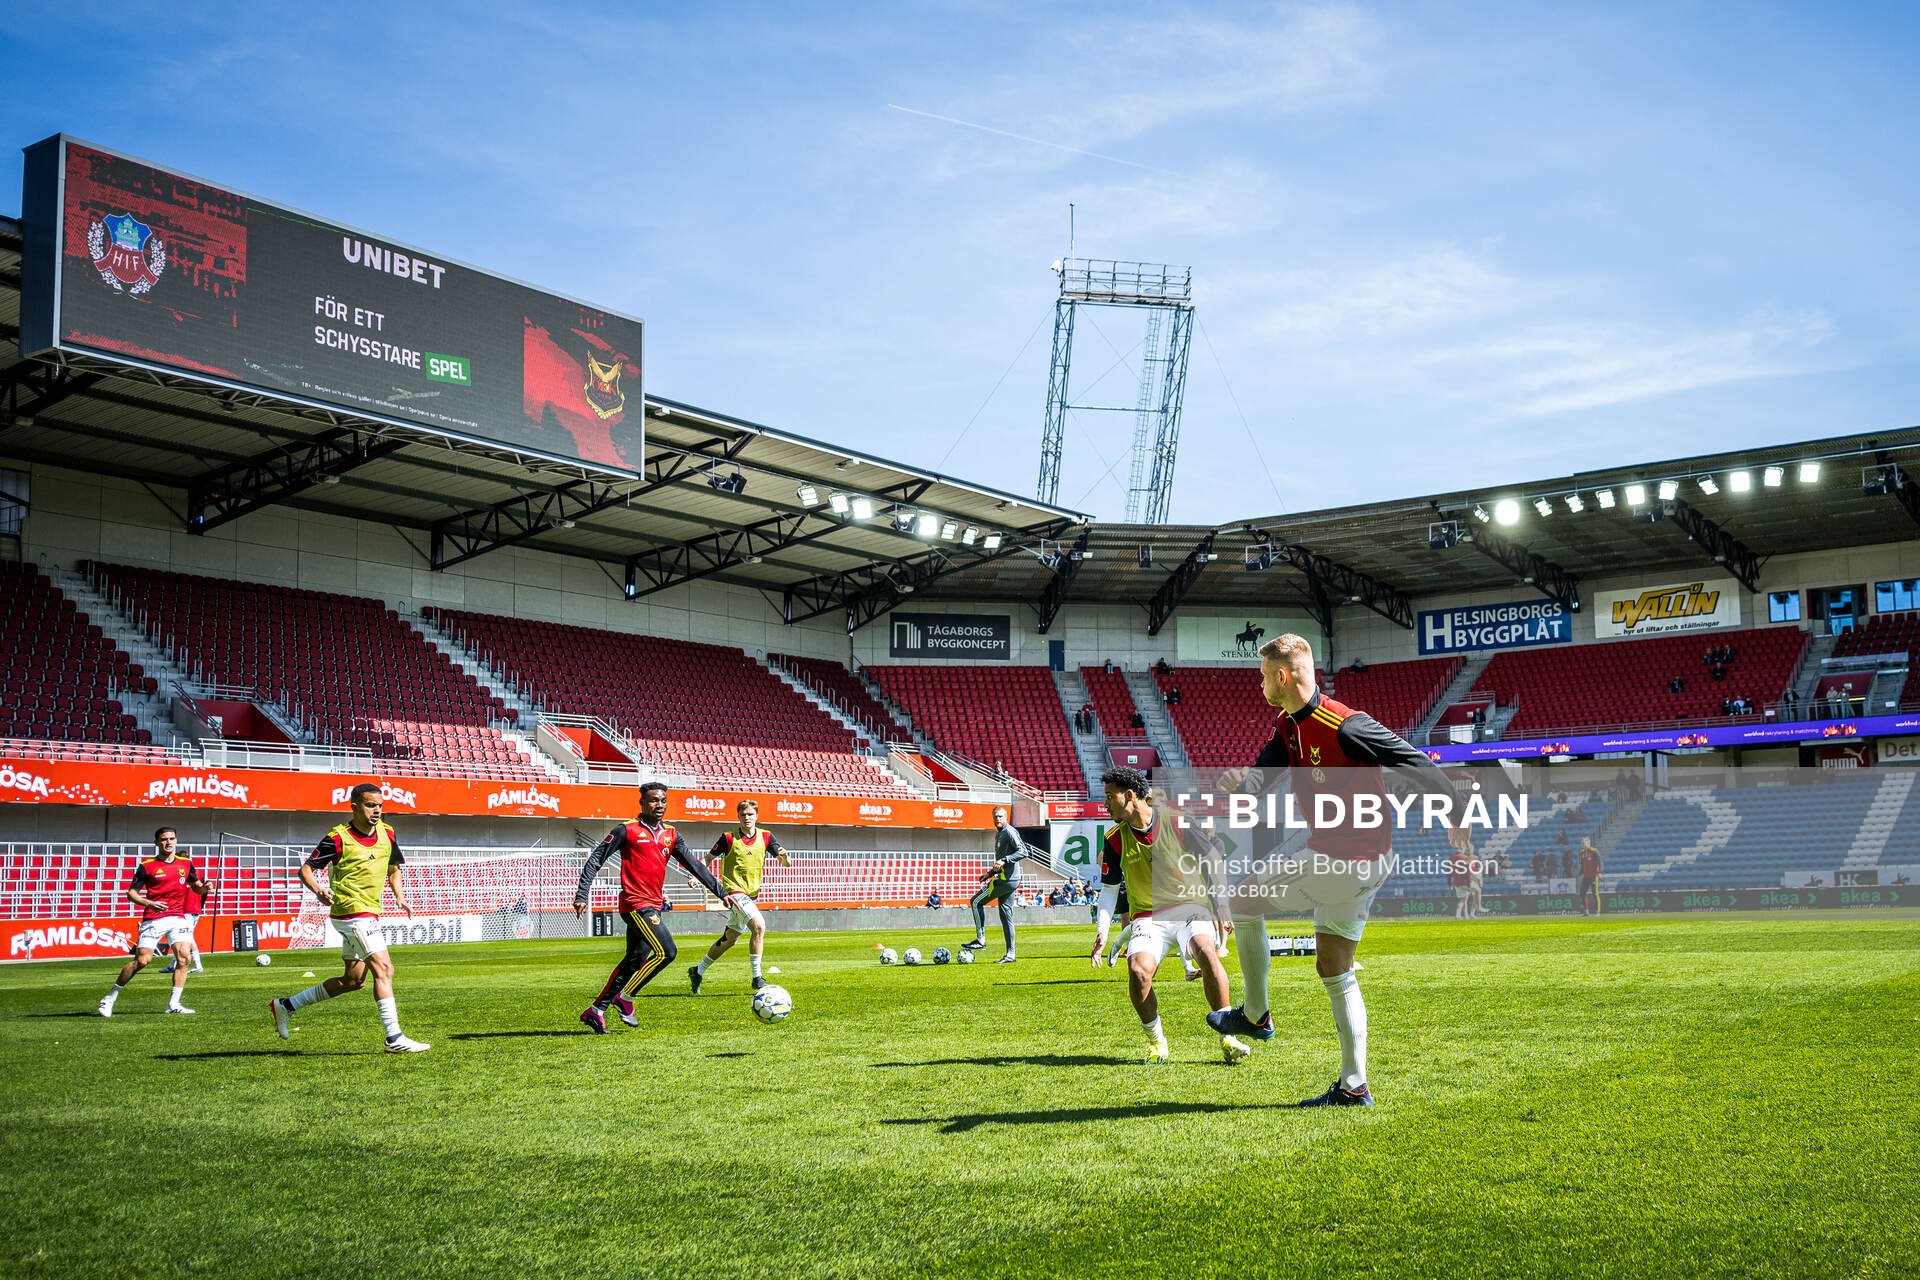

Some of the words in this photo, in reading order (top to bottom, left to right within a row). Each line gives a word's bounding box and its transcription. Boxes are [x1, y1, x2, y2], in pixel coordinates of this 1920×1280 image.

[112, 250, 140, 271] HIF
[343, 236, 446, 289] UNIBET
[314, 294, 348, 322] FÖR
[354, 306, 385, 332] ETT
[314, 325, 421, 370] SCHYSSTARE
[429, 357, 468, 380] SPEL
[1611, 582, 1721, 629] WALLIN
[927, 624, 994, 637] TÅGABORGS
[1455, 617, 1563, 648] BYGGPLÅT
[1623, 628, 1635, 636] hyr
[1636, 626, 1644, 634] ut
[1646, 625, 1663, 633] liftar
[1665, 624, 1679, 632] och
[1680, 620, 1720, 631] ställningar
[927, 638, 1006, 650] BYGGKONCEPT
[1885, 742, 1918, 757] Det
[150, 774, 248, 803] RAMLÖSA
[332, 782, 416, 808] RAÖSA
[685, 795, 714, 810] akea
[776, 799, 802, 812] akea
[859, 802, 883, 816] akea
[933, 805, 955, 818] akea
[1839, 873, 1860, 886] HK
[1537, 896, 1572, 910] akea
[1609, 894, 1645, 908] akea
[1683, 892, 1721, 907] akea
[1760, 890, 1799, 905] akea
[1840, 888, 1881, 903] akea
[1402, 899, 1434, 912] akea
[380, 917, 462, 945] mobil
